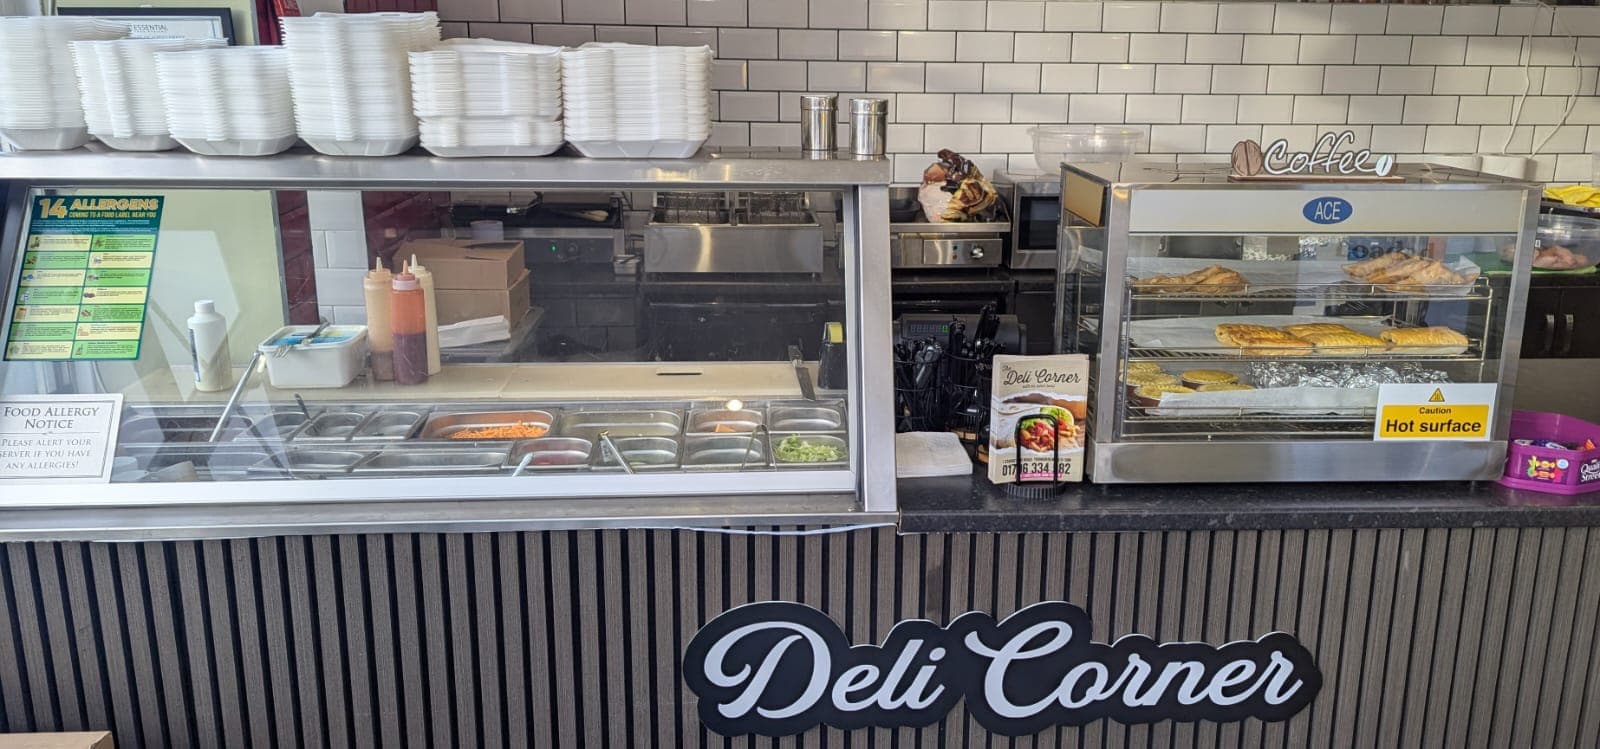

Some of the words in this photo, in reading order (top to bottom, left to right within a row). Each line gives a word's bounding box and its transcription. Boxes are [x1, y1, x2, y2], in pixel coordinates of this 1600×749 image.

[1263, 130, 1377, 175] Coffee
[39, 198, 68, 219] 14
[70, 198, 159, 211] ALLERGENS
[1314, 201, 1341, 220] ACE
[1003, 370, 1032, 385] Deli
[1035, 368, 1081, 383] Corner
[4, 407, 40, 417] FOOD
[44, 406, 100, 417] ALLERGY
[1419, 407, 1452, 415] Caution
[25, 419, 74, 429] NOTICE
[1386, 419, 1414, 433] Hot
[1419, 419, 1482, 433] surface
[1, 439, 33, 447] PLEASE
[33, 450, 42, 458] IF
[44, 449, 65, 457] YOU
[5, 462, 24, 470] ANY
[27, 460, 79, 470] ALLERGIES!
[1002, 463, 1028, 476] 0176
[1031, 462, 1049, 473] 334
[702, 621, 946, 719] Deli
[964, 620, 1305, 719] Corner
